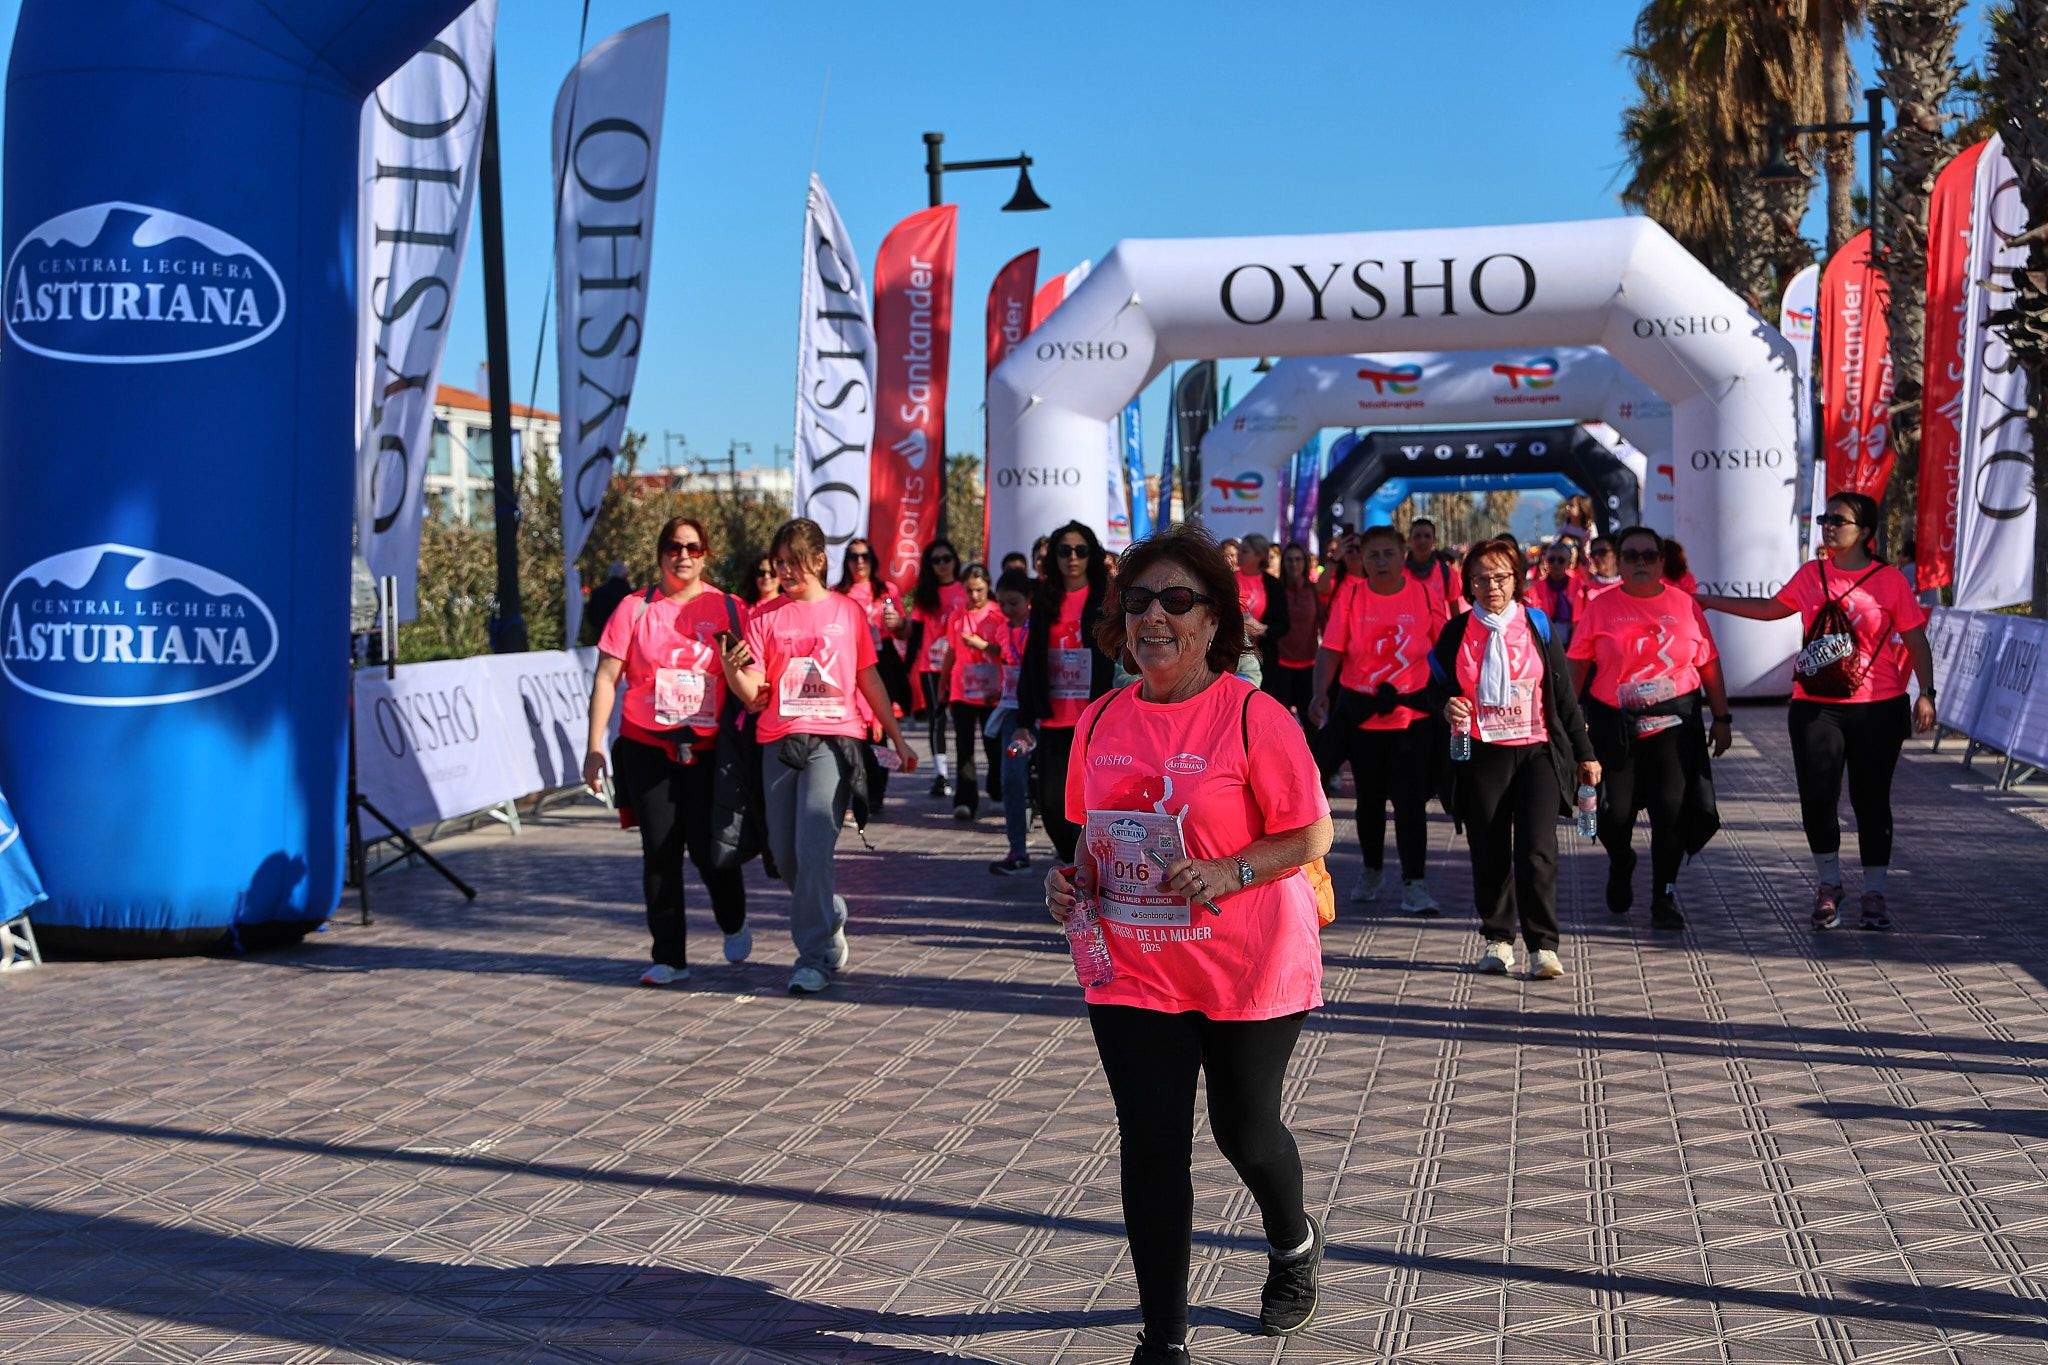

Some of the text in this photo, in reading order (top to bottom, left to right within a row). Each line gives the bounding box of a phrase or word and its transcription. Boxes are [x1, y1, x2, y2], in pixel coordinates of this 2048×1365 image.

[38, 257, 253, 279] CENTRAL LECHERA
[11, 265, 263, 327] ASTURIANA
[1220, 253, 1536, 326] OYSHO
[1632, 315, 1731, 339] OYSHO
[1036, 341, 1128, 362] OYSHO
[1840, 280, 1864, 422] Santander
[891, 255, 934, 582] Sports Santander
[1401, 441, 1547, 460] VOLVO
[1691, 448, 1782, 472] OYSHO
[997, 467, 1081, 488] OYSHO
[32, 600, 245, 618] CENTRAL LECHERA
[5, 602, 255, 665] ASTURIANA
[375, 685, 479, 758] OYSHO
[1498, 705, 1522, 717] 016
[1095, 755, 1132, 766] OYSHO
[1114, 861, 1149, 881] 016
[1120, 884, 1137, 894] 8347
[1139, 912, 1175, 920] Santander
[1136, 928, 1151, 941] DE
[1153, 929, 1167, 942] LA
[1170, 926, 1212, 942] MUJER
[1140, 943, 1161, 954] 2025
